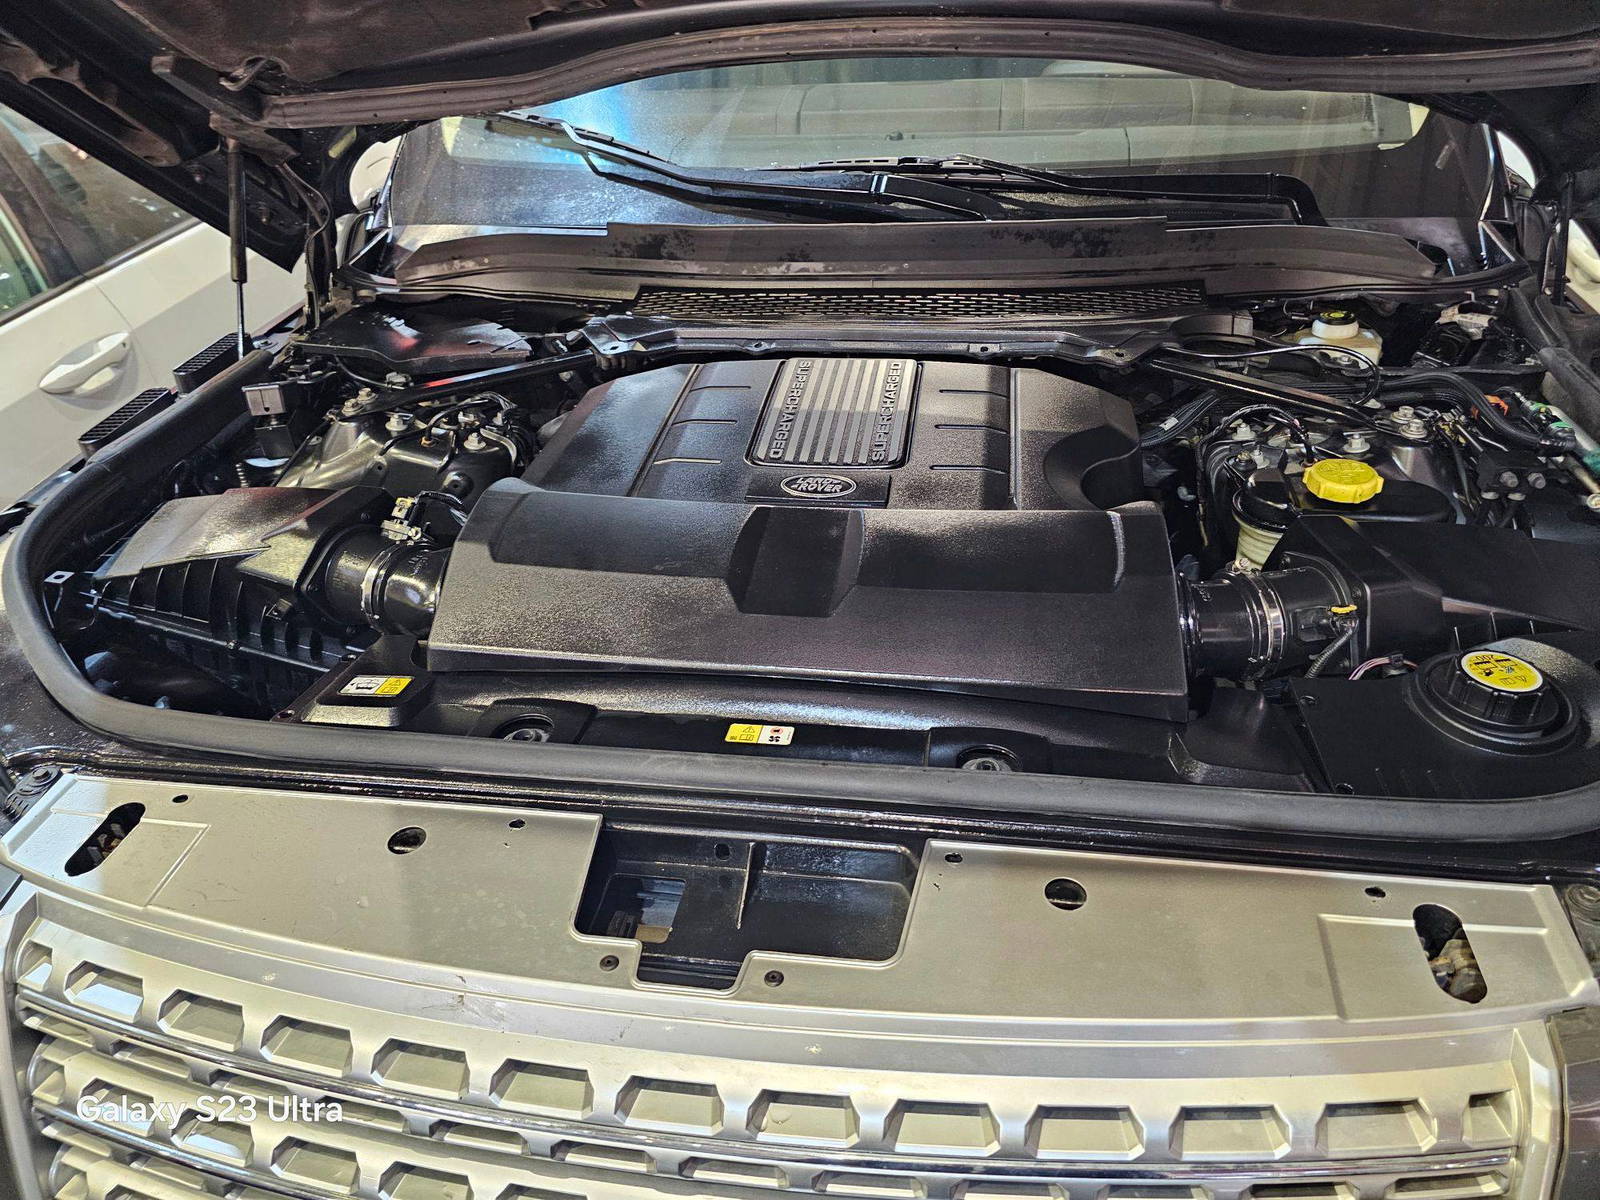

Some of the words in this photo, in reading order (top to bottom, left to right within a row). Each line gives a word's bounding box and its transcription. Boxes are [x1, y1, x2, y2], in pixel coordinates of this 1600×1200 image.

[769, 359, 812, 460] SUPERCHARGED
[871, 361, 901, 463] SUPERCHARGED
[796, 477, 835, 485] LAND
[797, 482, 843, 493] ROVER
